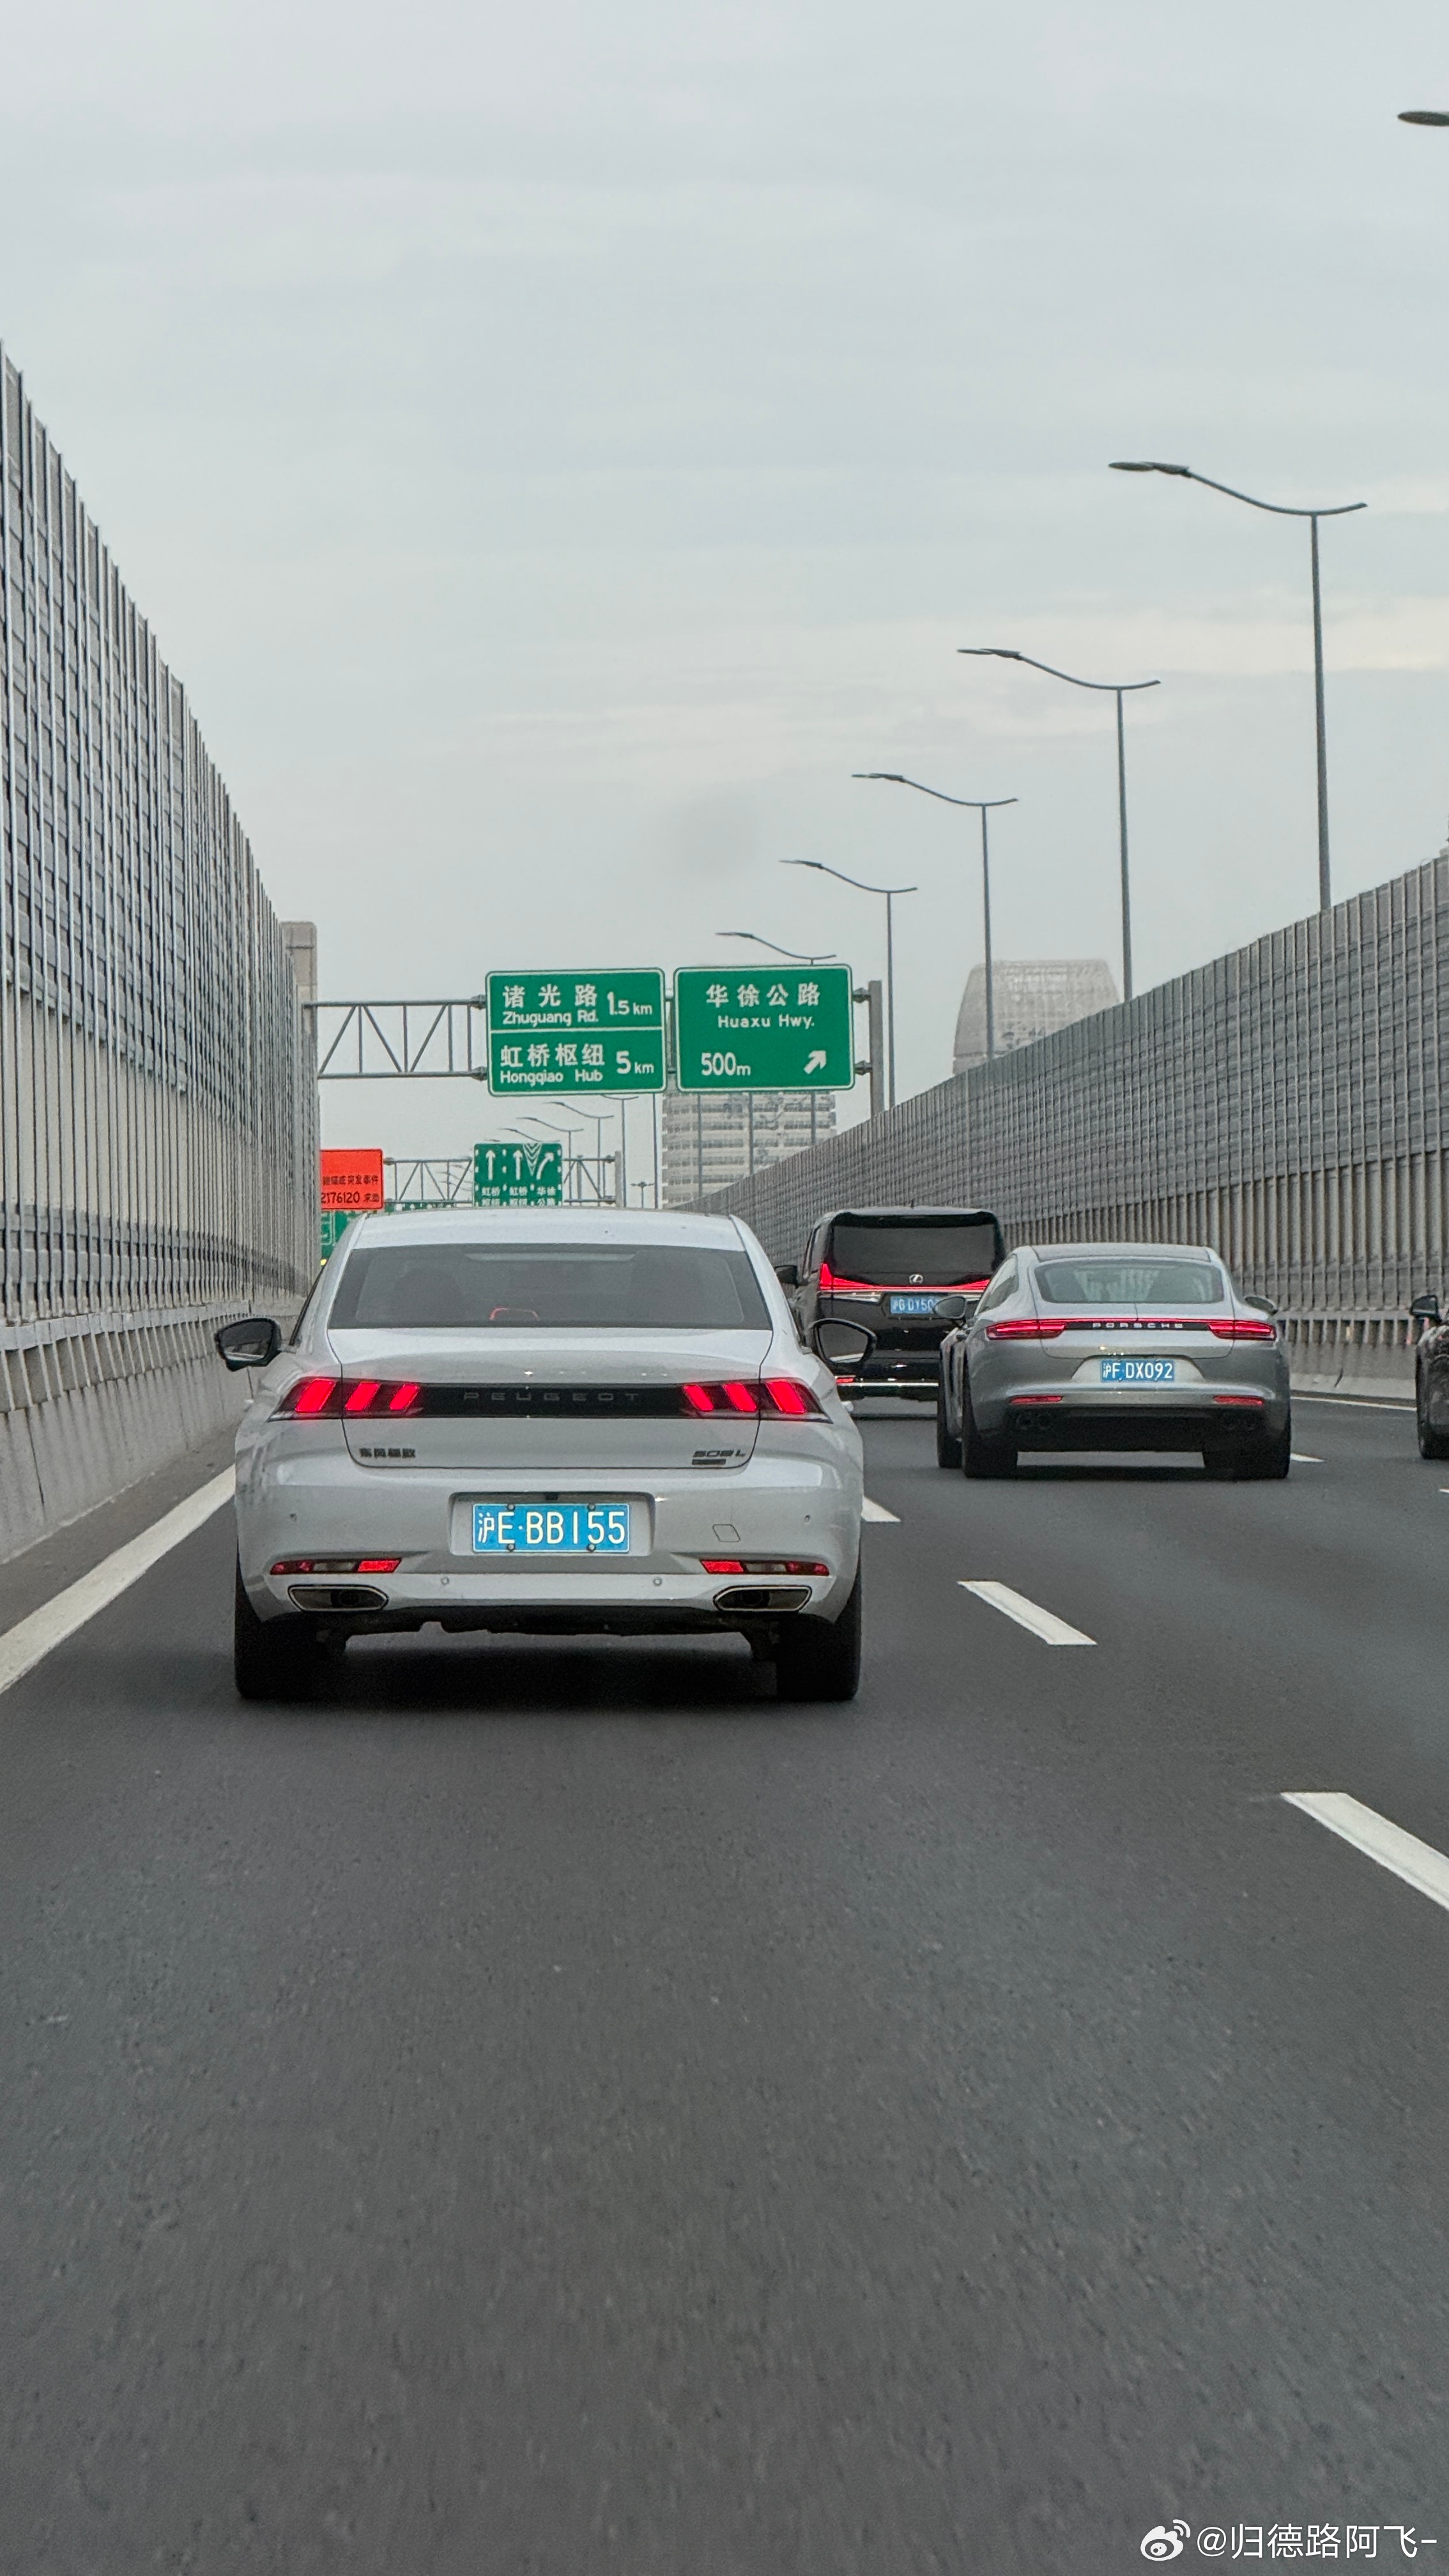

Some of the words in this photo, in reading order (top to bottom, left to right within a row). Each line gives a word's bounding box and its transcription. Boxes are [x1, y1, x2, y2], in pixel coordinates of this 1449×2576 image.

[502, 983, 598, 1009] 诸光路
[706, 981, 820, 1008] 华徐公路
[502, 1011, 572, 1027] Zhuguang
[578, 1009, 599, 1023] Rd.
[632, 1002, 653, 1015] km
[717, 1015, 770, 1028] Huaxu
[778, 1013, 815, 1029] Hwy.
[500, 1042, 606, 1068] 虹桥枢纽
[615, 1050, 632, 1075] 5
[634, 1061, 654, 1075] km
[500, 1070, 564, 1087] Hongqiao
[575, 1068, 604, 1083] Hub
[464, 1392, 638, 1401] PEUGEOT
